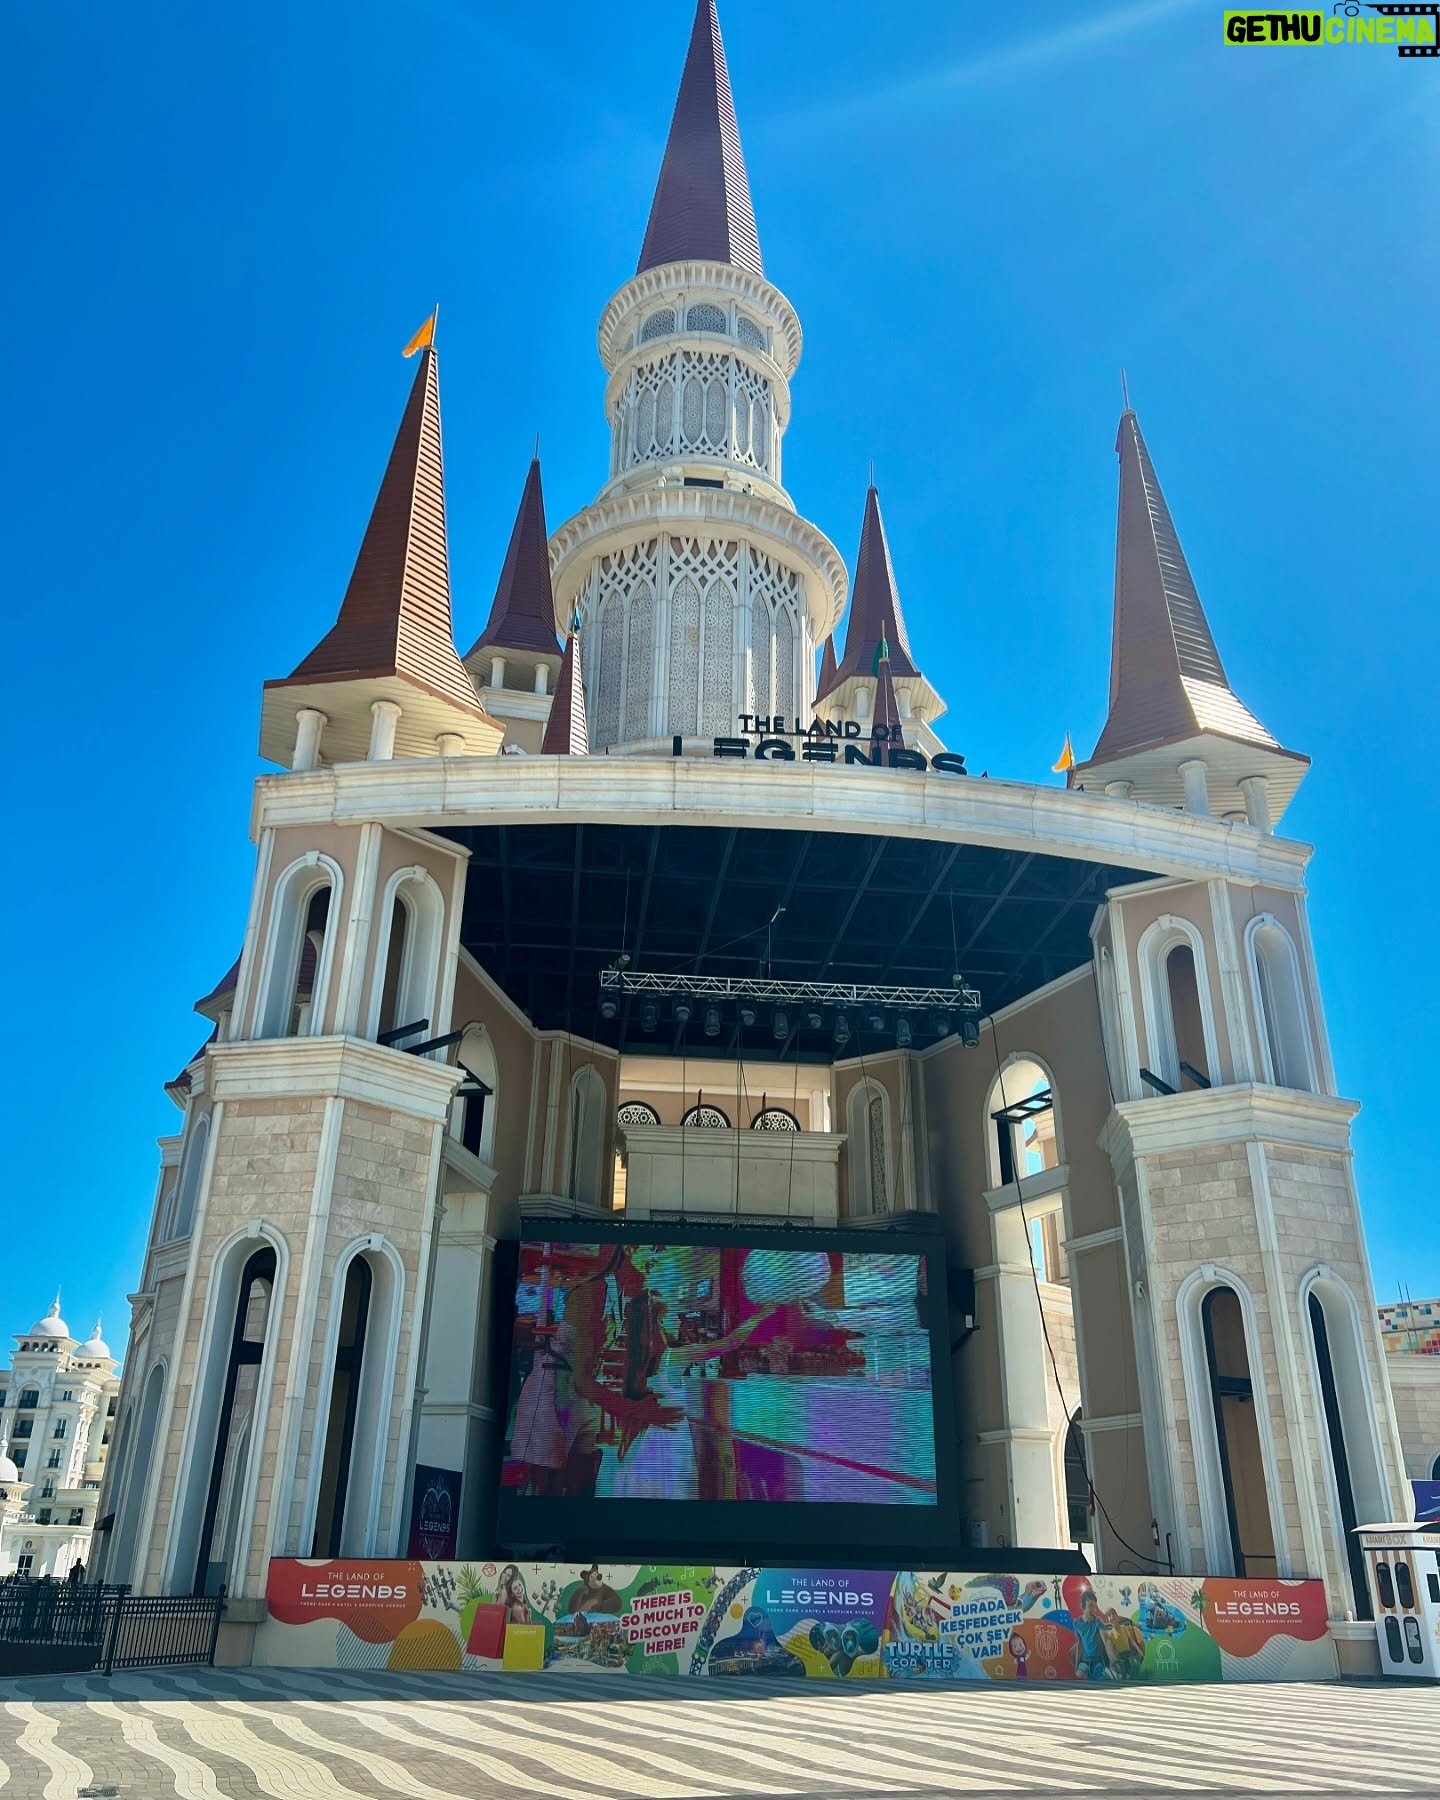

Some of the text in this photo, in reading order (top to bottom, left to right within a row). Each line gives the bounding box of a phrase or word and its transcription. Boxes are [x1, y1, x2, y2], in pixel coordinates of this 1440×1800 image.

[738, 714, 903, 741] THE LAND OF
[327, 1572, 385, 1581] THE LAND OF
[792, 1578, 850, 1588] THE LAND OF
[301, 1583, 407, 1599] LEGENDS
[766, 1590, 874, 1606] LEGENDS
[1233, 1590, 1247, 1598] THE
[1270, 1590, 1280, 1598] OF
[633, 1592, 691, 1611] THERE IS
[952, 1599, 1006, 1616] BURADA
[1214, 1601, 1300, 1615] LEGENDS
[621, 1605, 704, 1627] SO MUCH TO
[941, 1611, 1022, 1633] KEŞFEDECEK
[629, 1621, 699, 1641] DISCOVER
[957, 1628, 1011, 1648] ÇOK ŞEY
[646, 1637, 686, 1654] HERE!
[886, 1642, 953, 1658] TURTLE
[972, 1644, 1002, 1659] VAR!
[891, 1658, 952, 1669] COATER
